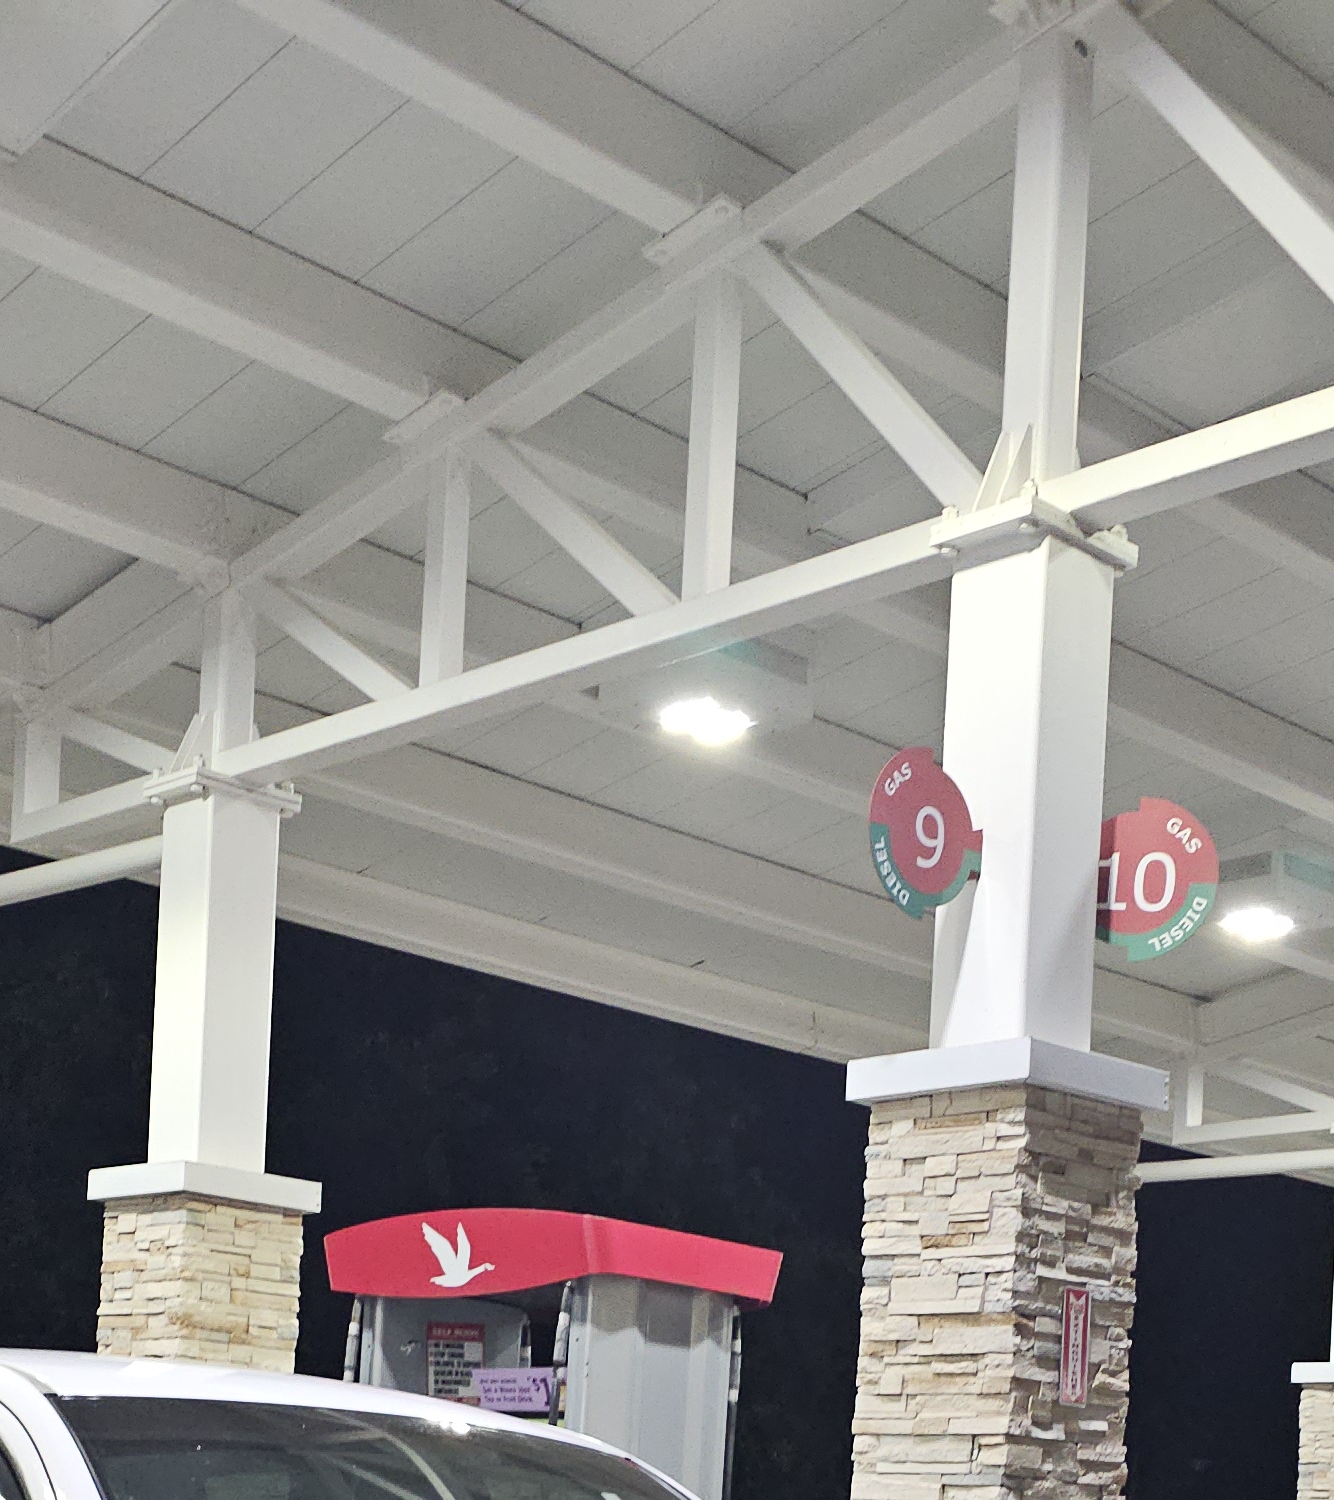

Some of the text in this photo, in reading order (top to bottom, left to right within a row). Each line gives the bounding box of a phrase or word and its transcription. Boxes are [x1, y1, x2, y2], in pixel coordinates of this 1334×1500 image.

[883, 761, 913, 797] GAS
[915, 805, 945, 869] 9
[1166, 817, 1203, 854] GAS
[874, 836, 911, 906] DIESEL
[1097, 851, 1177, 913] 10
[1148, 896, 1209, 951] DIESEL
